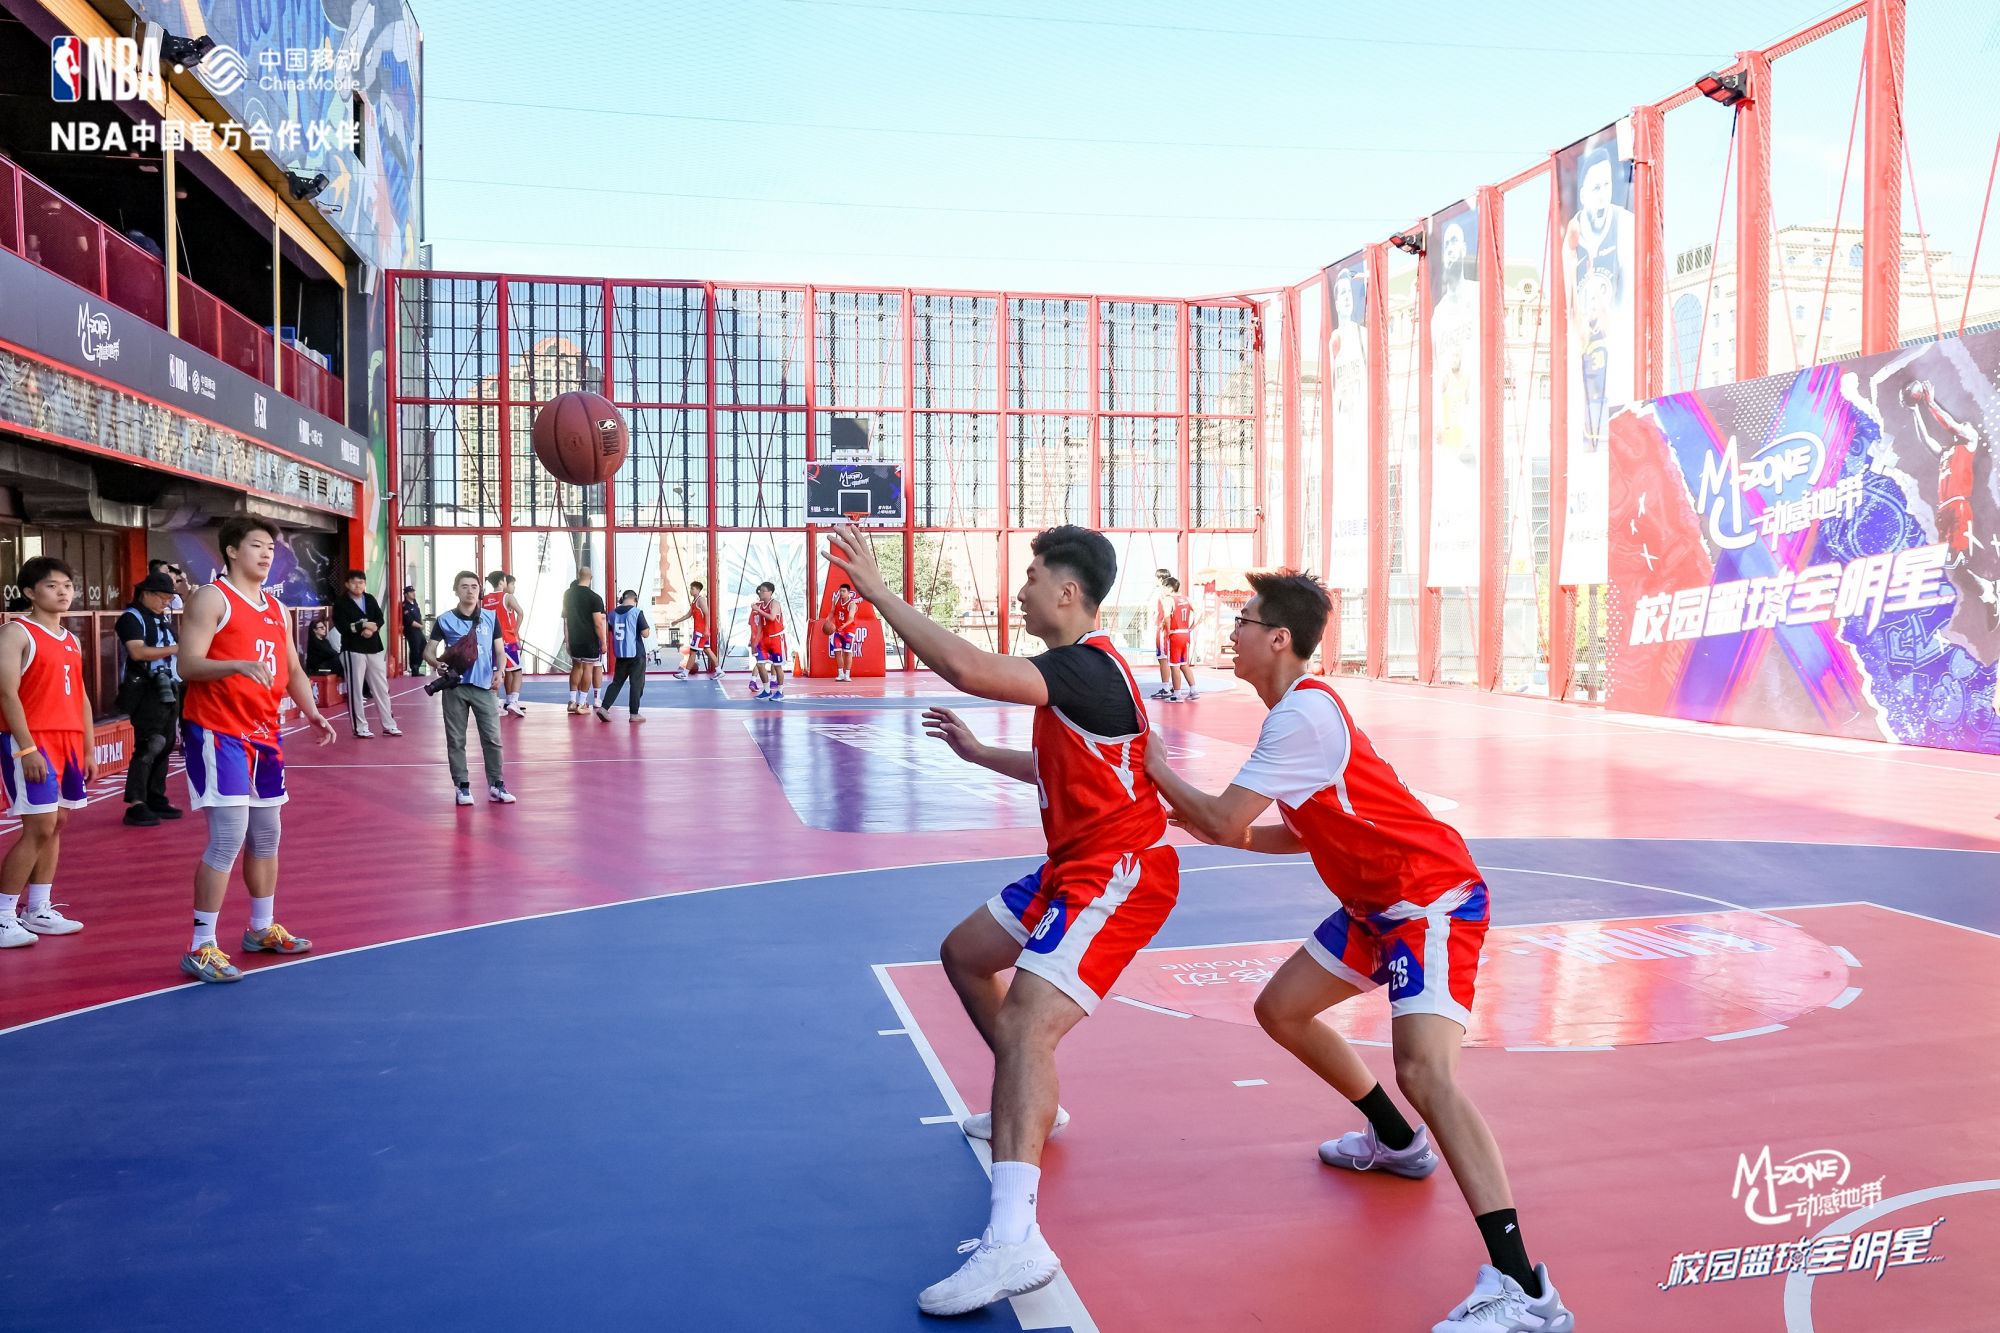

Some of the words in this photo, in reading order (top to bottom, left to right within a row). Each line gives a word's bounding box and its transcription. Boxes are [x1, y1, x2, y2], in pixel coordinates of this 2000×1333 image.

[1750, 464, 1870, 552] 动感地带
[1630, 543, 1952, 645] 校园篮球全明星
[615, 622, 626, 641] 5
[856, 627, 868, 643] OP
[255, 638, 277, 677] 23
[63, 664, 71, 696] 3
[1388, 955, 1409, 991] 26
